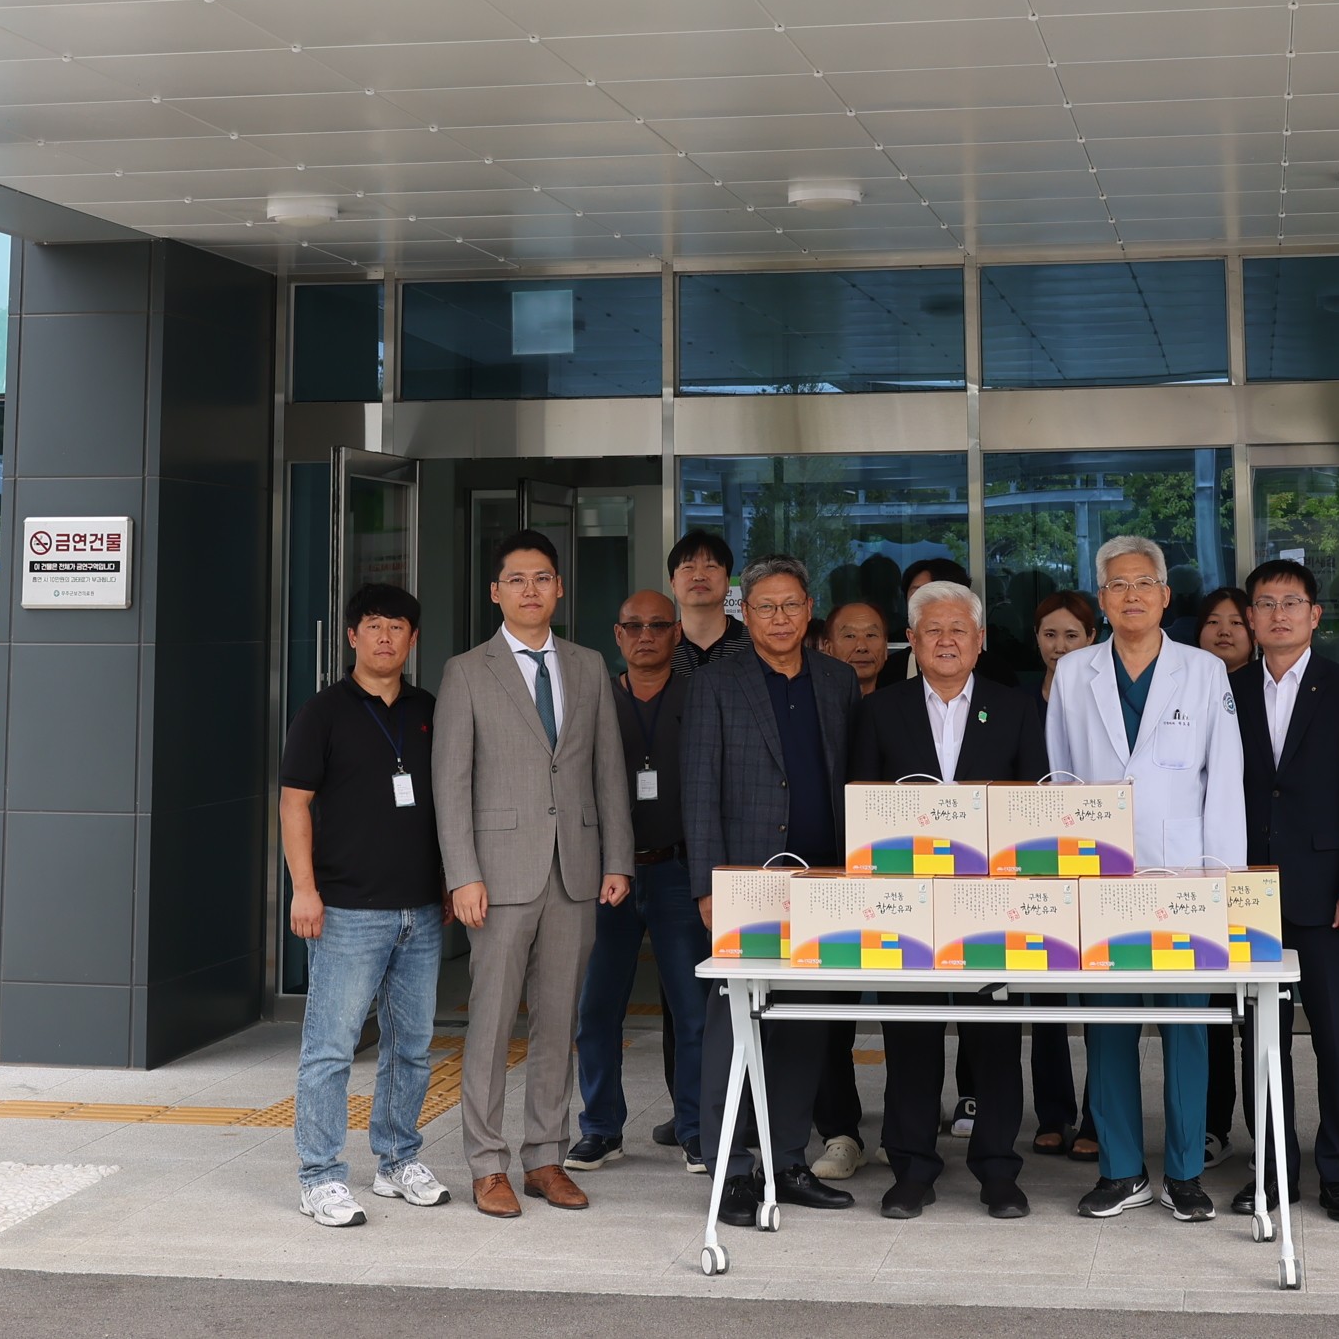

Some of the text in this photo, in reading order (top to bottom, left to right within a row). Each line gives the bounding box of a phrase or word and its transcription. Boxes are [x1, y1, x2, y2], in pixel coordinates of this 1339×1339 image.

[56, 533, 121, 552] 금연건물
[723, 598, 742, 607] 20:0
[938, 798, 959, 808] 구천동
[1082, 798, 1103, 808] 구천동
[1230, 885, 1251, 895] 구천동
[883, 892, 904, 901] 구천동
[1028, 892, 1049, 902] 구천동
[1176, 891, 1197, 901] 구천동
